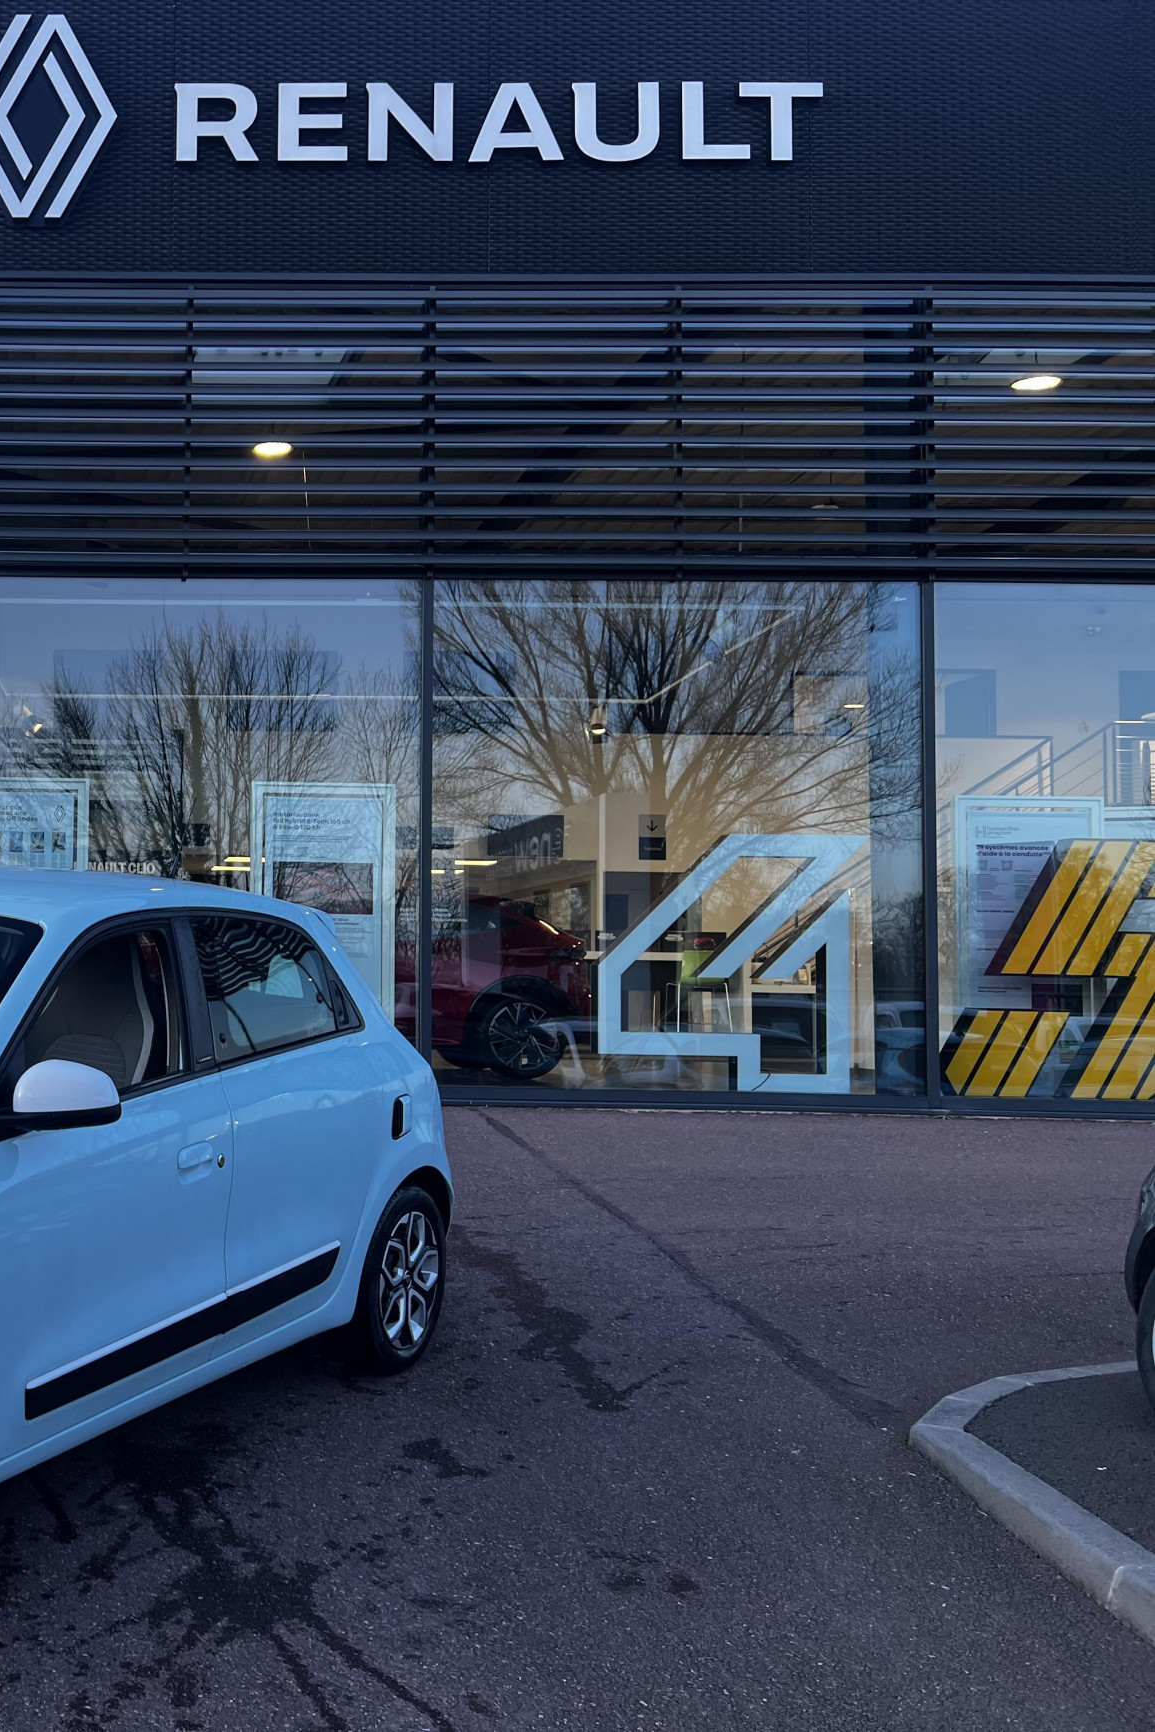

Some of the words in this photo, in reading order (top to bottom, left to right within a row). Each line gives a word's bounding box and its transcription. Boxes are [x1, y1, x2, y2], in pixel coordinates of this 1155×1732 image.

[174, 82, 824, 163] RENAULT
[985, 844, 1018, 852] systèmes
[74, 861, 127, 874] NAULT
[128, 862, 156, 875] CLIO
